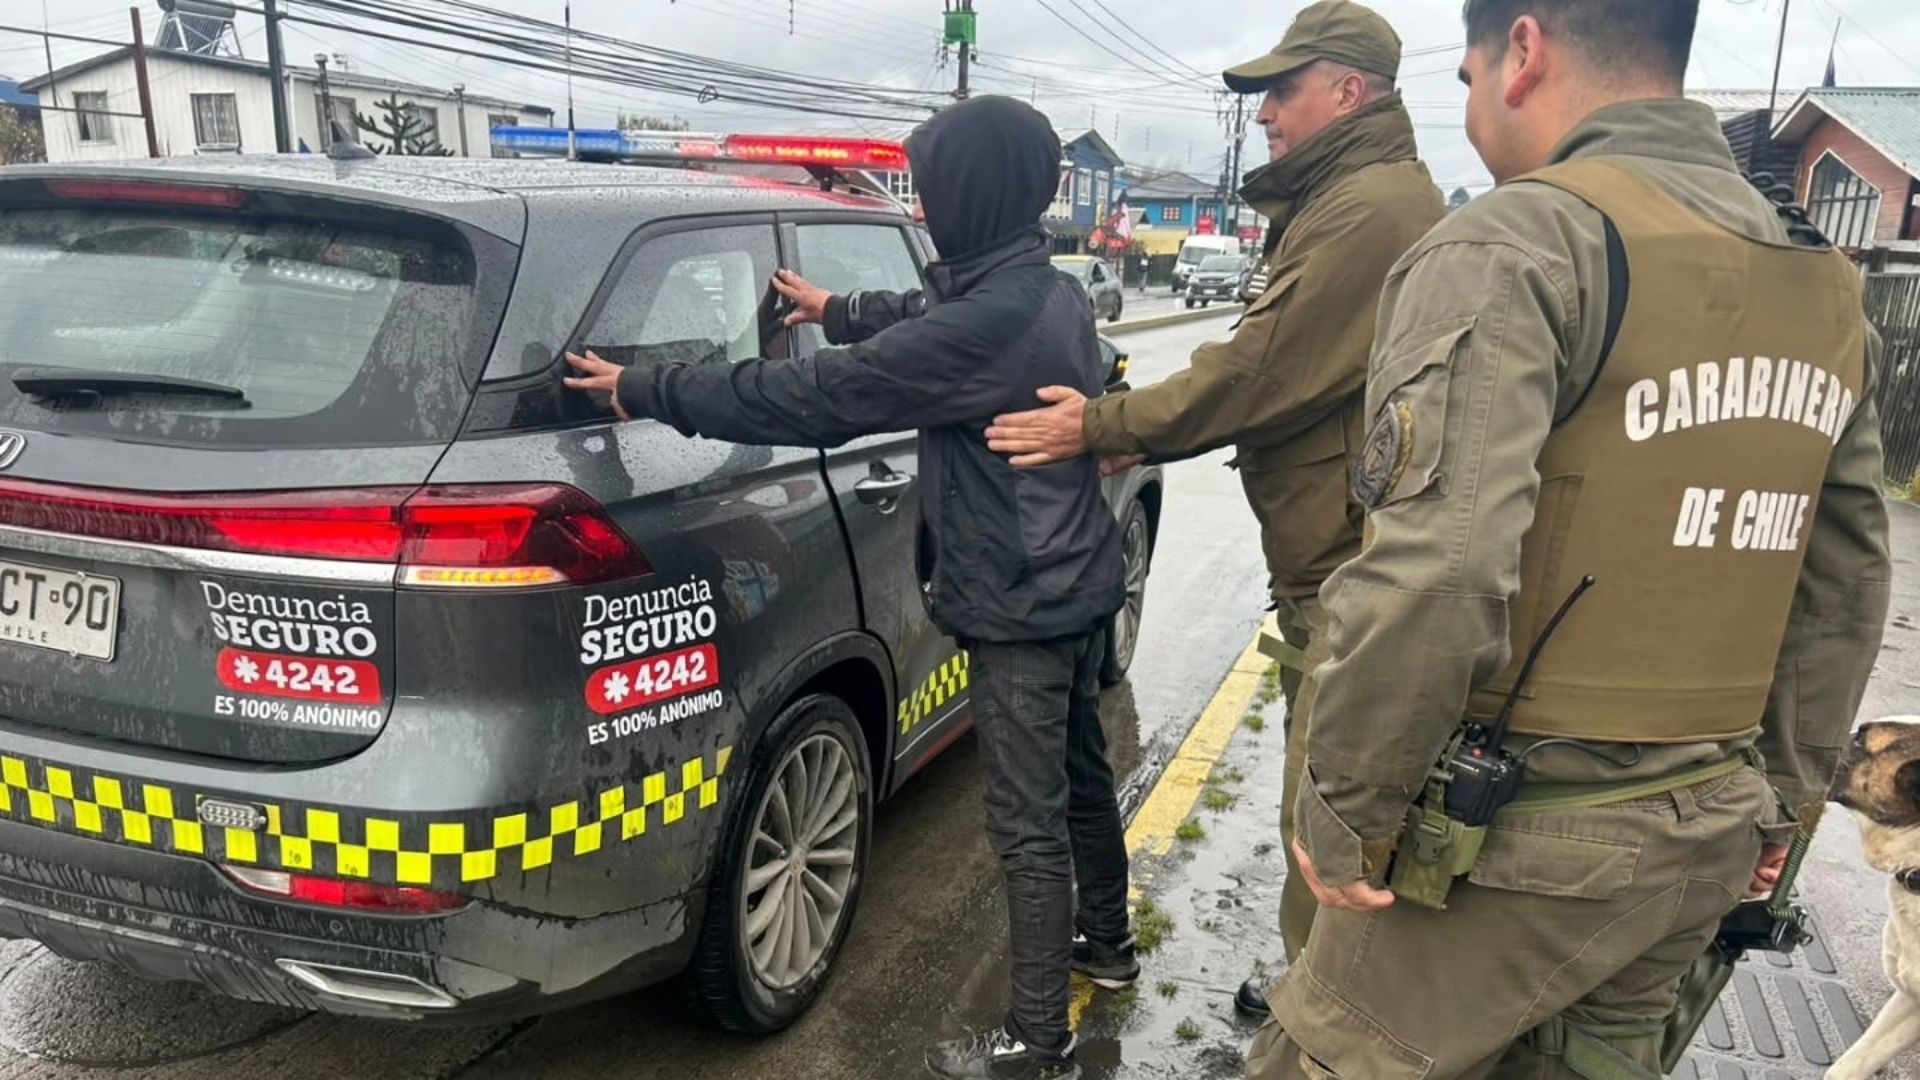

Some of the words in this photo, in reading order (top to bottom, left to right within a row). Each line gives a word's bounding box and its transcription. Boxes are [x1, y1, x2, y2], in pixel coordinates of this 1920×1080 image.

[1624, 356, 1857, 446] CARABINERO
[1672, 486, 1726, 548] DE
[1730, 489, 1810, 551] CHILE
[200, 580, 372, 623] Denuncia
[583, 574, 713, 627] Denuncia
[3, 624, 49, 643] HILE
[210, 611, 377, 657] SEGURO
[580, 604, 717, 665] SEGURO
[214, 695, 235, 715] ES
[238, 698, 289, 721] 100%
[292, 703, 381, 729] ANÓNIMO
[587, 722, 609, 745] ES
[611, 710, 657, 738] 100%
[659, 689, 723, 726] ANÓNIMO
